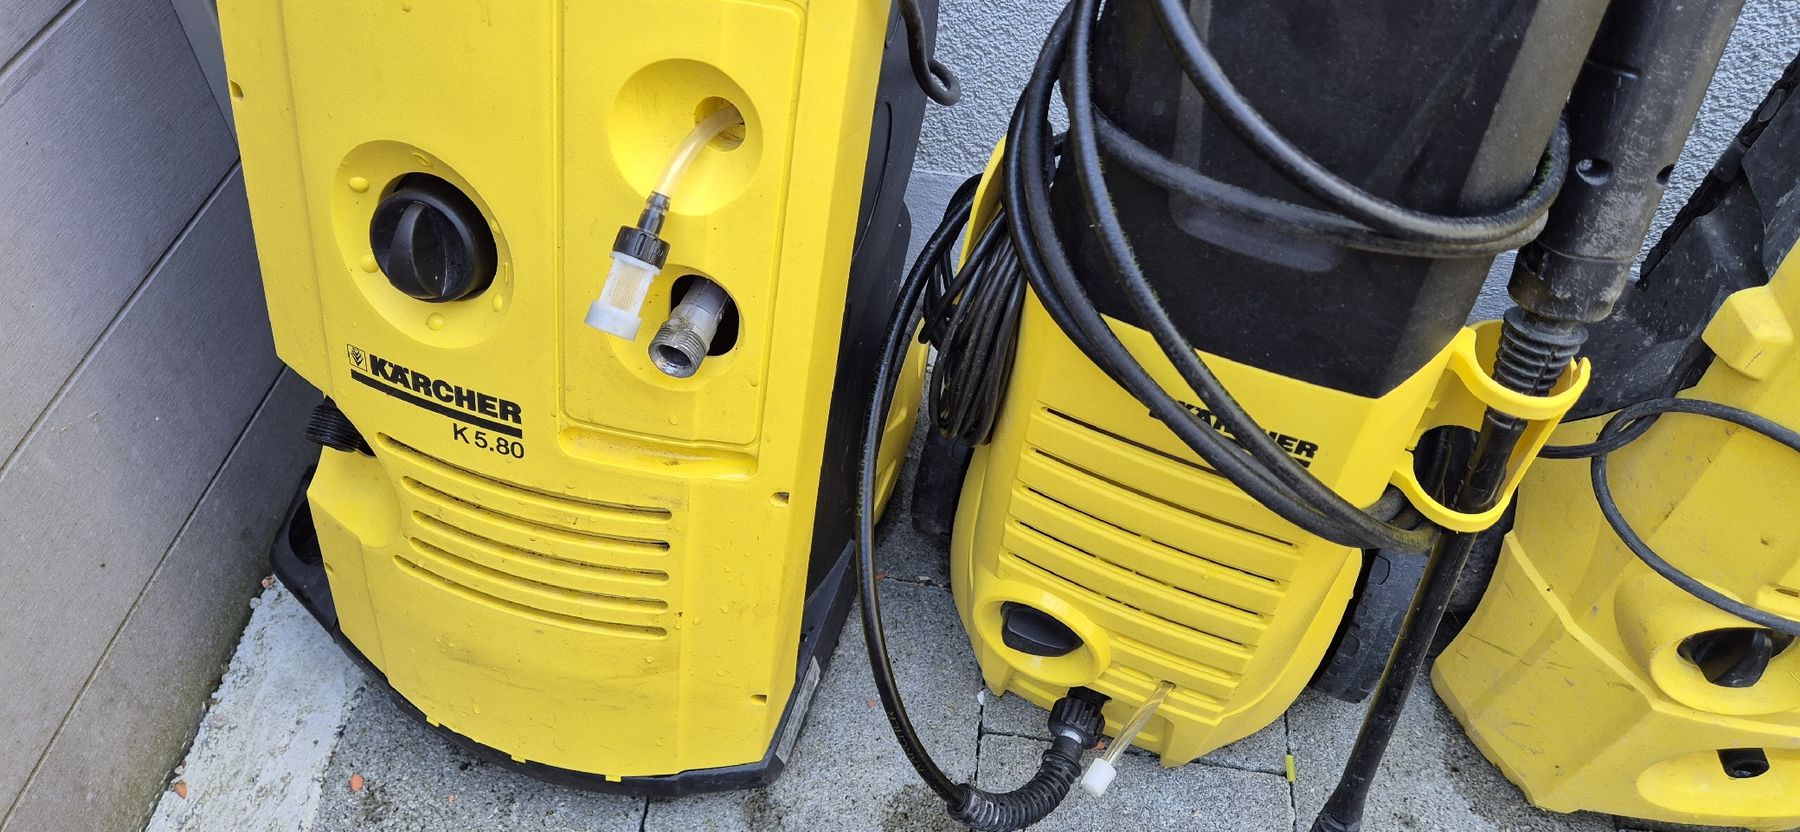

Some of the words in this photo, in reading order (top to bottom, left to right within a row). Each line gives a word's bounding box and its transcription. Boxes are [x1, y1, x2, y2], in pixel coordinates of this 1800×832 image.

[369, 353, 523, 425] KÄRCHER
[453, 422, 470, 444] K
[474, 430, 525, 459] 5.80
